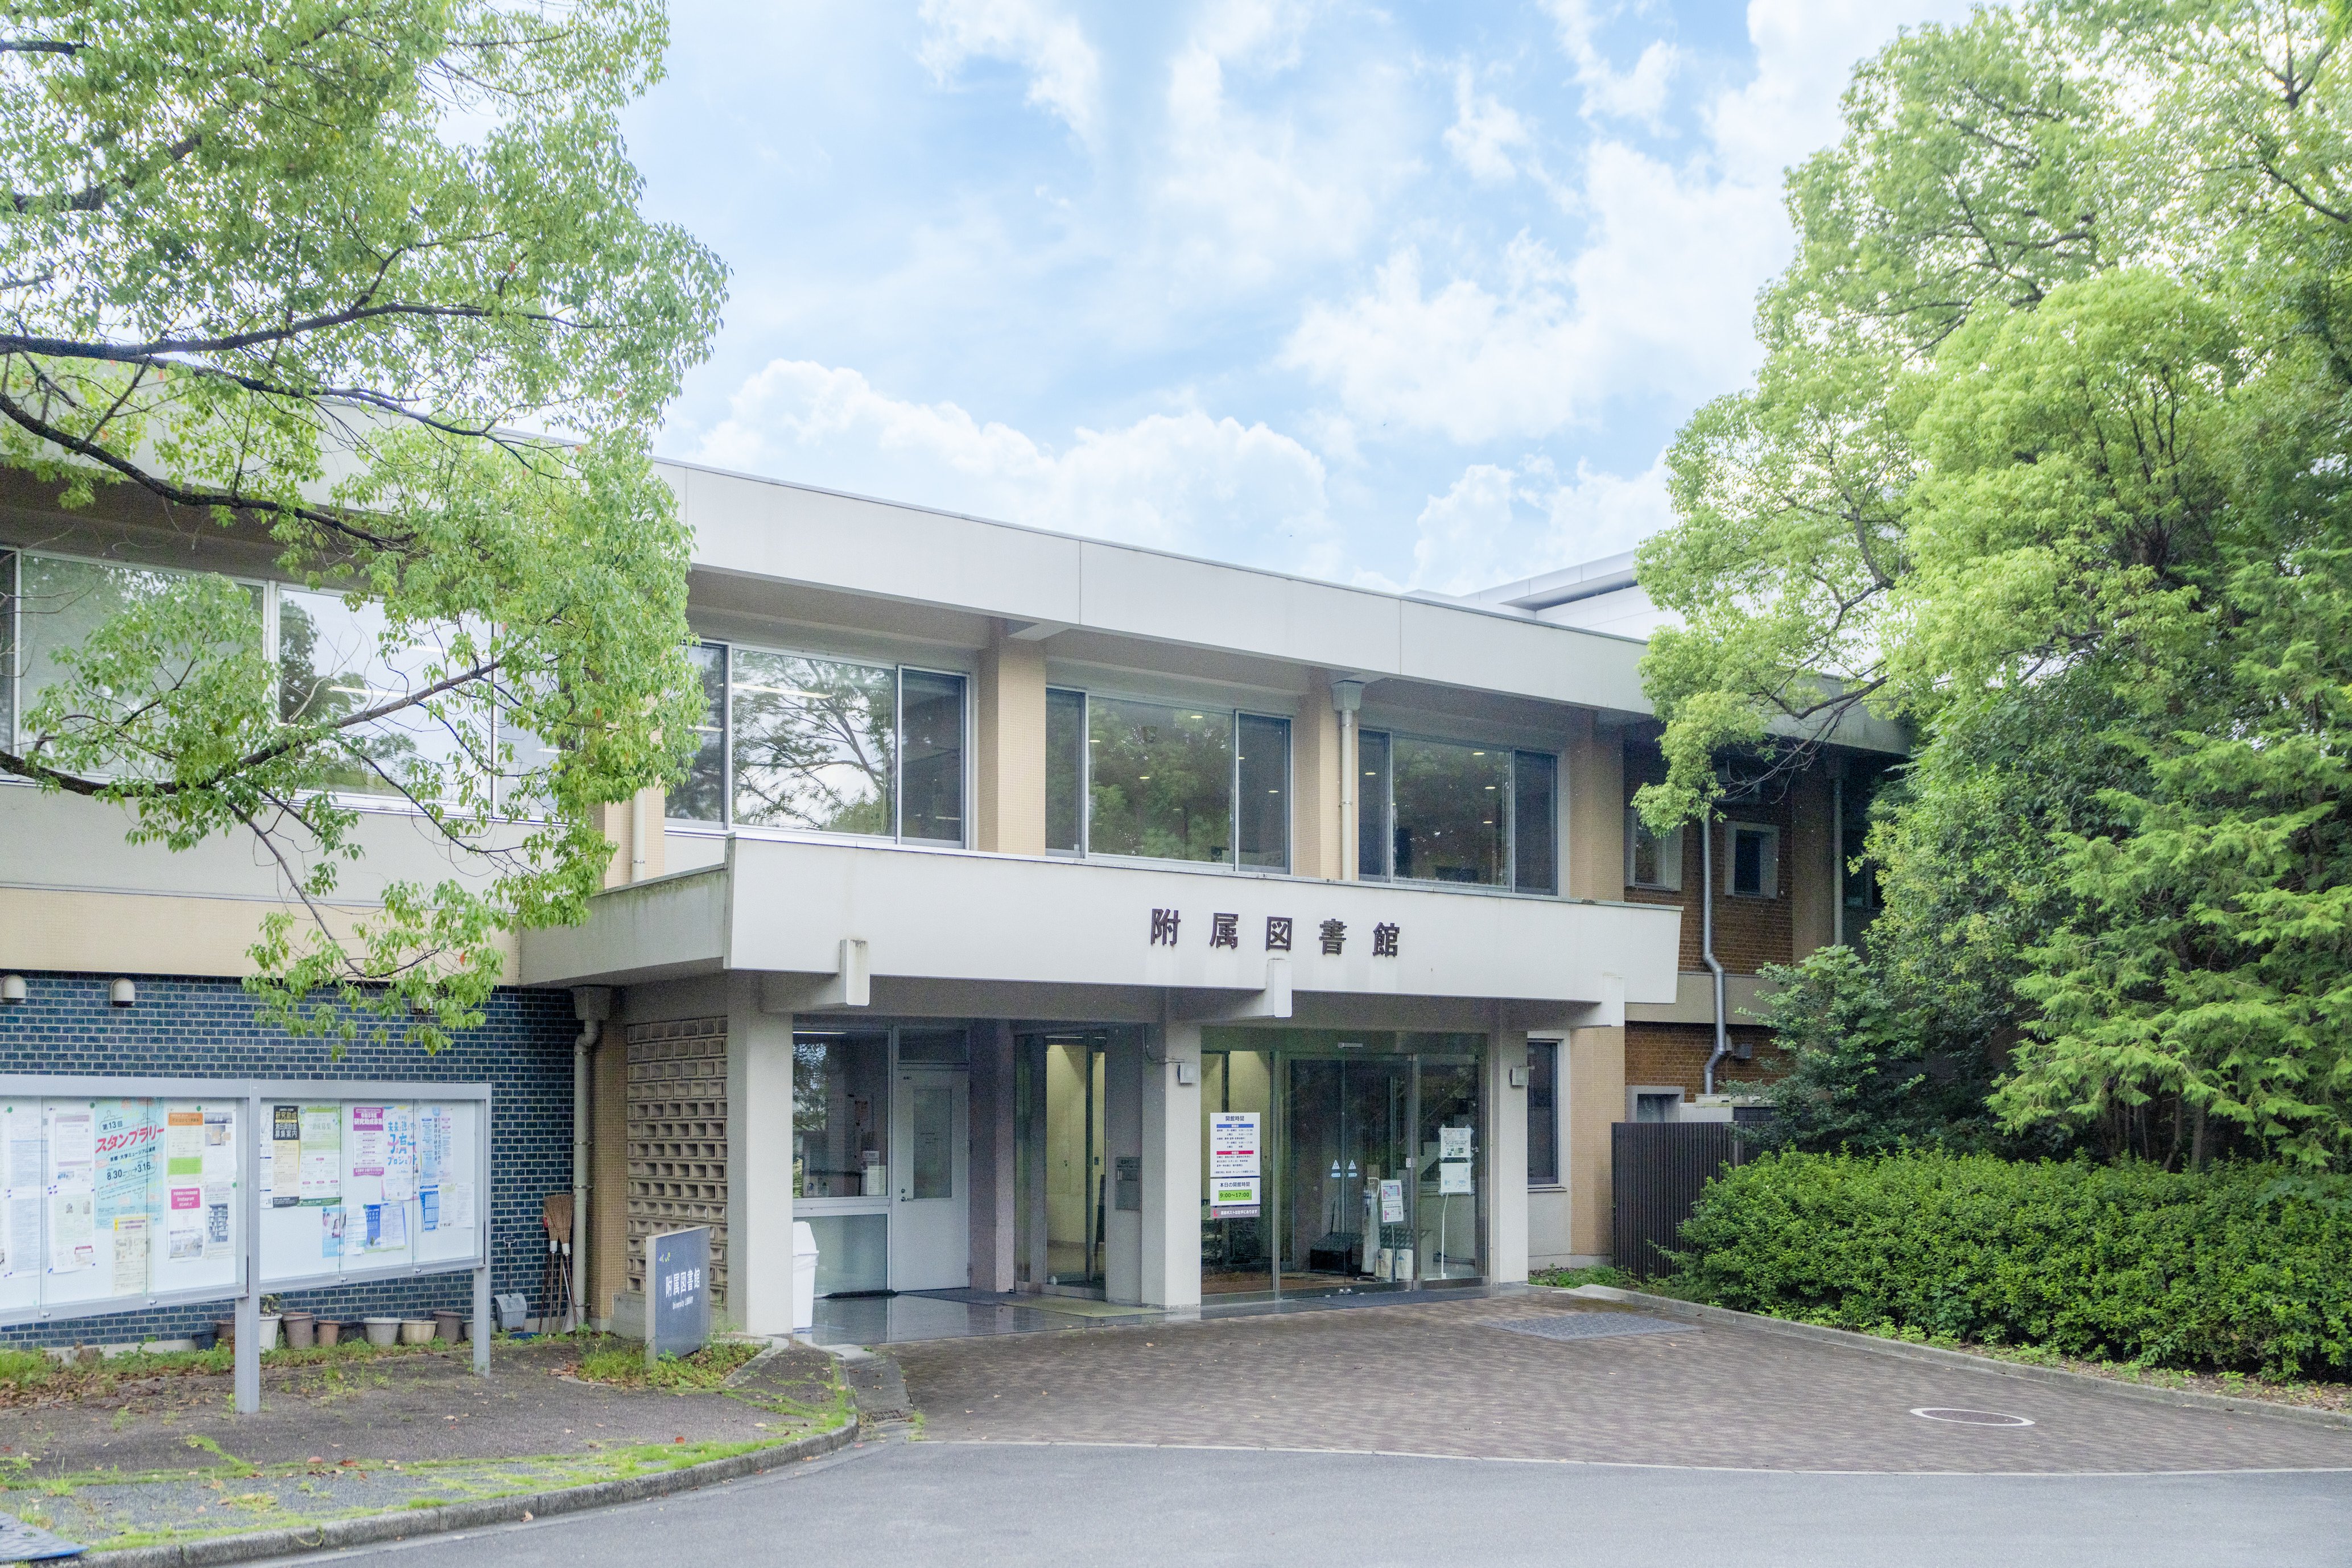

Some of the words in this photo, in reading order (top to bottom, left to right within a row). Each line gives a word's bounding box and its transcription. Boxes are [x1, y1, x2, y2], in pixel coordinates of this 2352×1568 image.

[1150, 909, 1400, 957] 附属図書館
[102, 1120, 123, 1130] 第13回
[275, 1111, 297, 1120] 研究助成
[95, 1124, 164, 1154] スタンプラリー
[387, 1132, 417, 1154] 子育て
[387, 1154, 417, 1166] プロジェクト
[107, 1169, 122, 1180] 8.30
[138, 1162, 151, 1173] 3.16
[666, 1267, 700, 1298] 附属図書館
